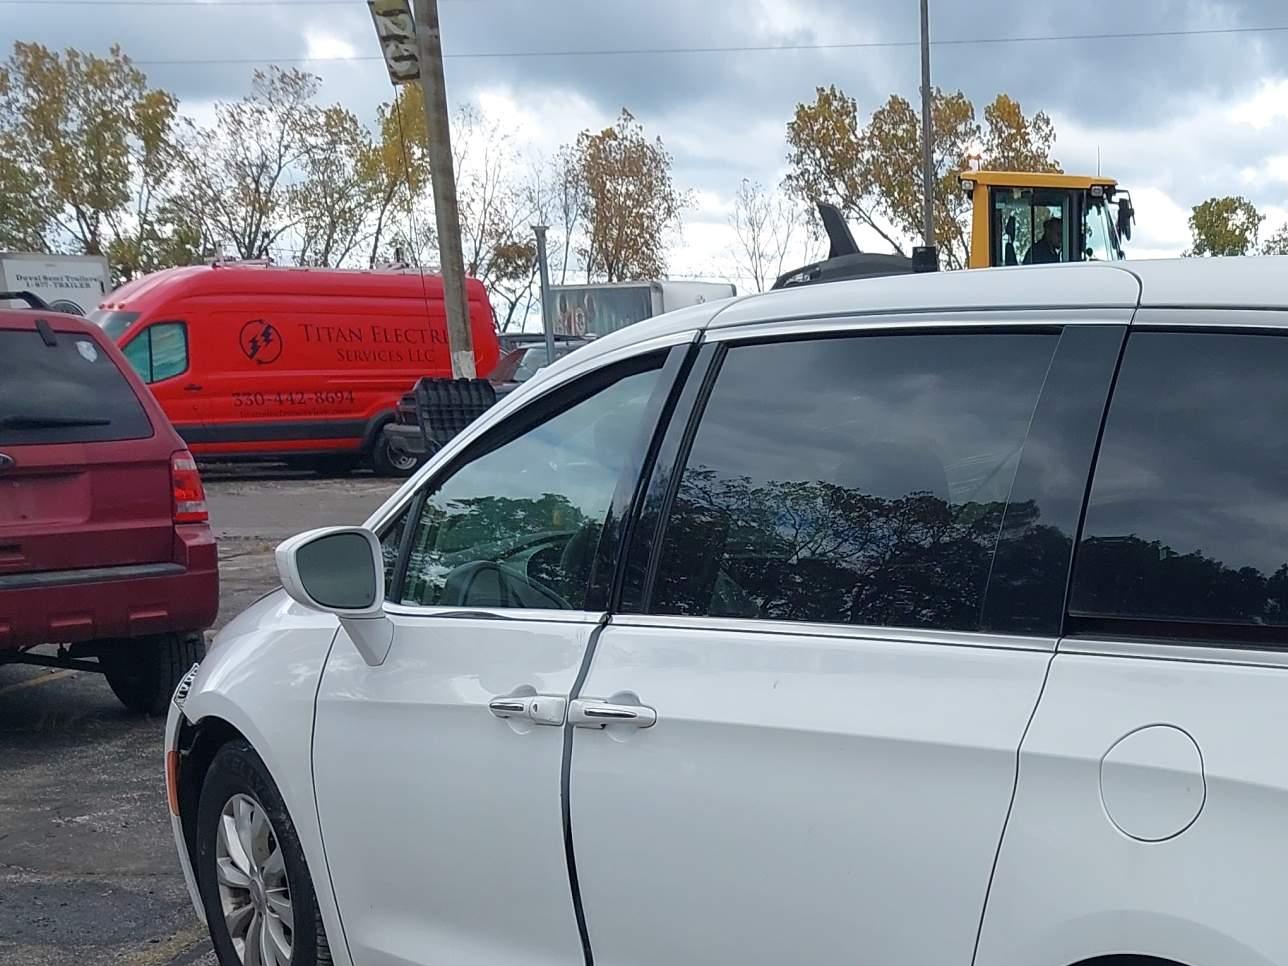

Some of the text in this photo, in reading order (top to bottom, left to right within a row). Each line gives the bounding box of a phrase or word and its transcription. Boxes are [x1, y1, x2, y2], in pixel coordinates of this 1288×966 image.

[298, 323, 449, 345] TITAN ELECTRI
[336, 348, 435, 363] SERVICES LLC
[231, 389, 355, 407] 330-442-8694
